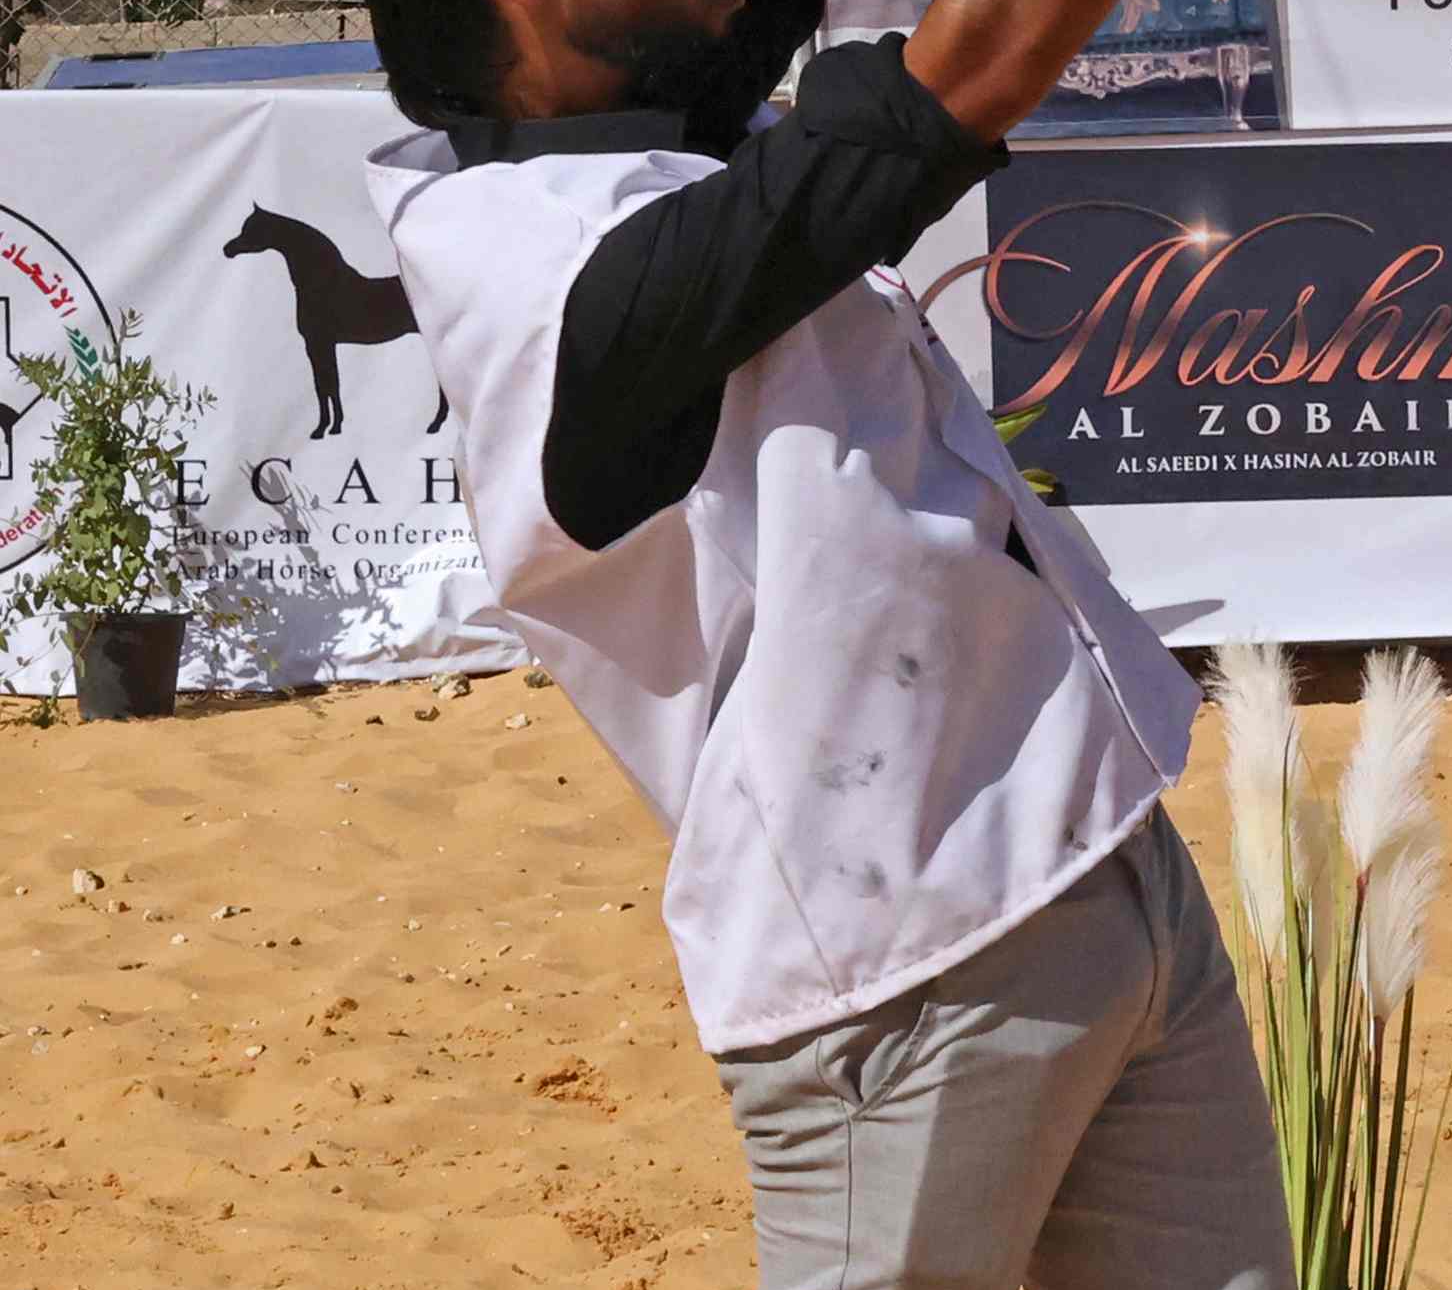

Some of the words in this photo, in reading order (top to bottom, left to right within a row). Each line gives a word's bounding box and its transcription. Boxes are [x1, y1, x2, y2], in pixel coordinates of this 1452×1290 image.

[1067, 406, 1145, 440] AL
[1116, 457, 1142, 473] AL
[1147, 455, 1218, 473] SAEEDI
[1224, 454, 1237, 471] X
[1244, 452, 1324, 471] HASINA
[1327, 451, 1353, 469] AL
[1357, 450, 1437, 469] ZOBAIR
[256, 558, 337, 581] Horse
[354, 555, 486, 582] Organizat
